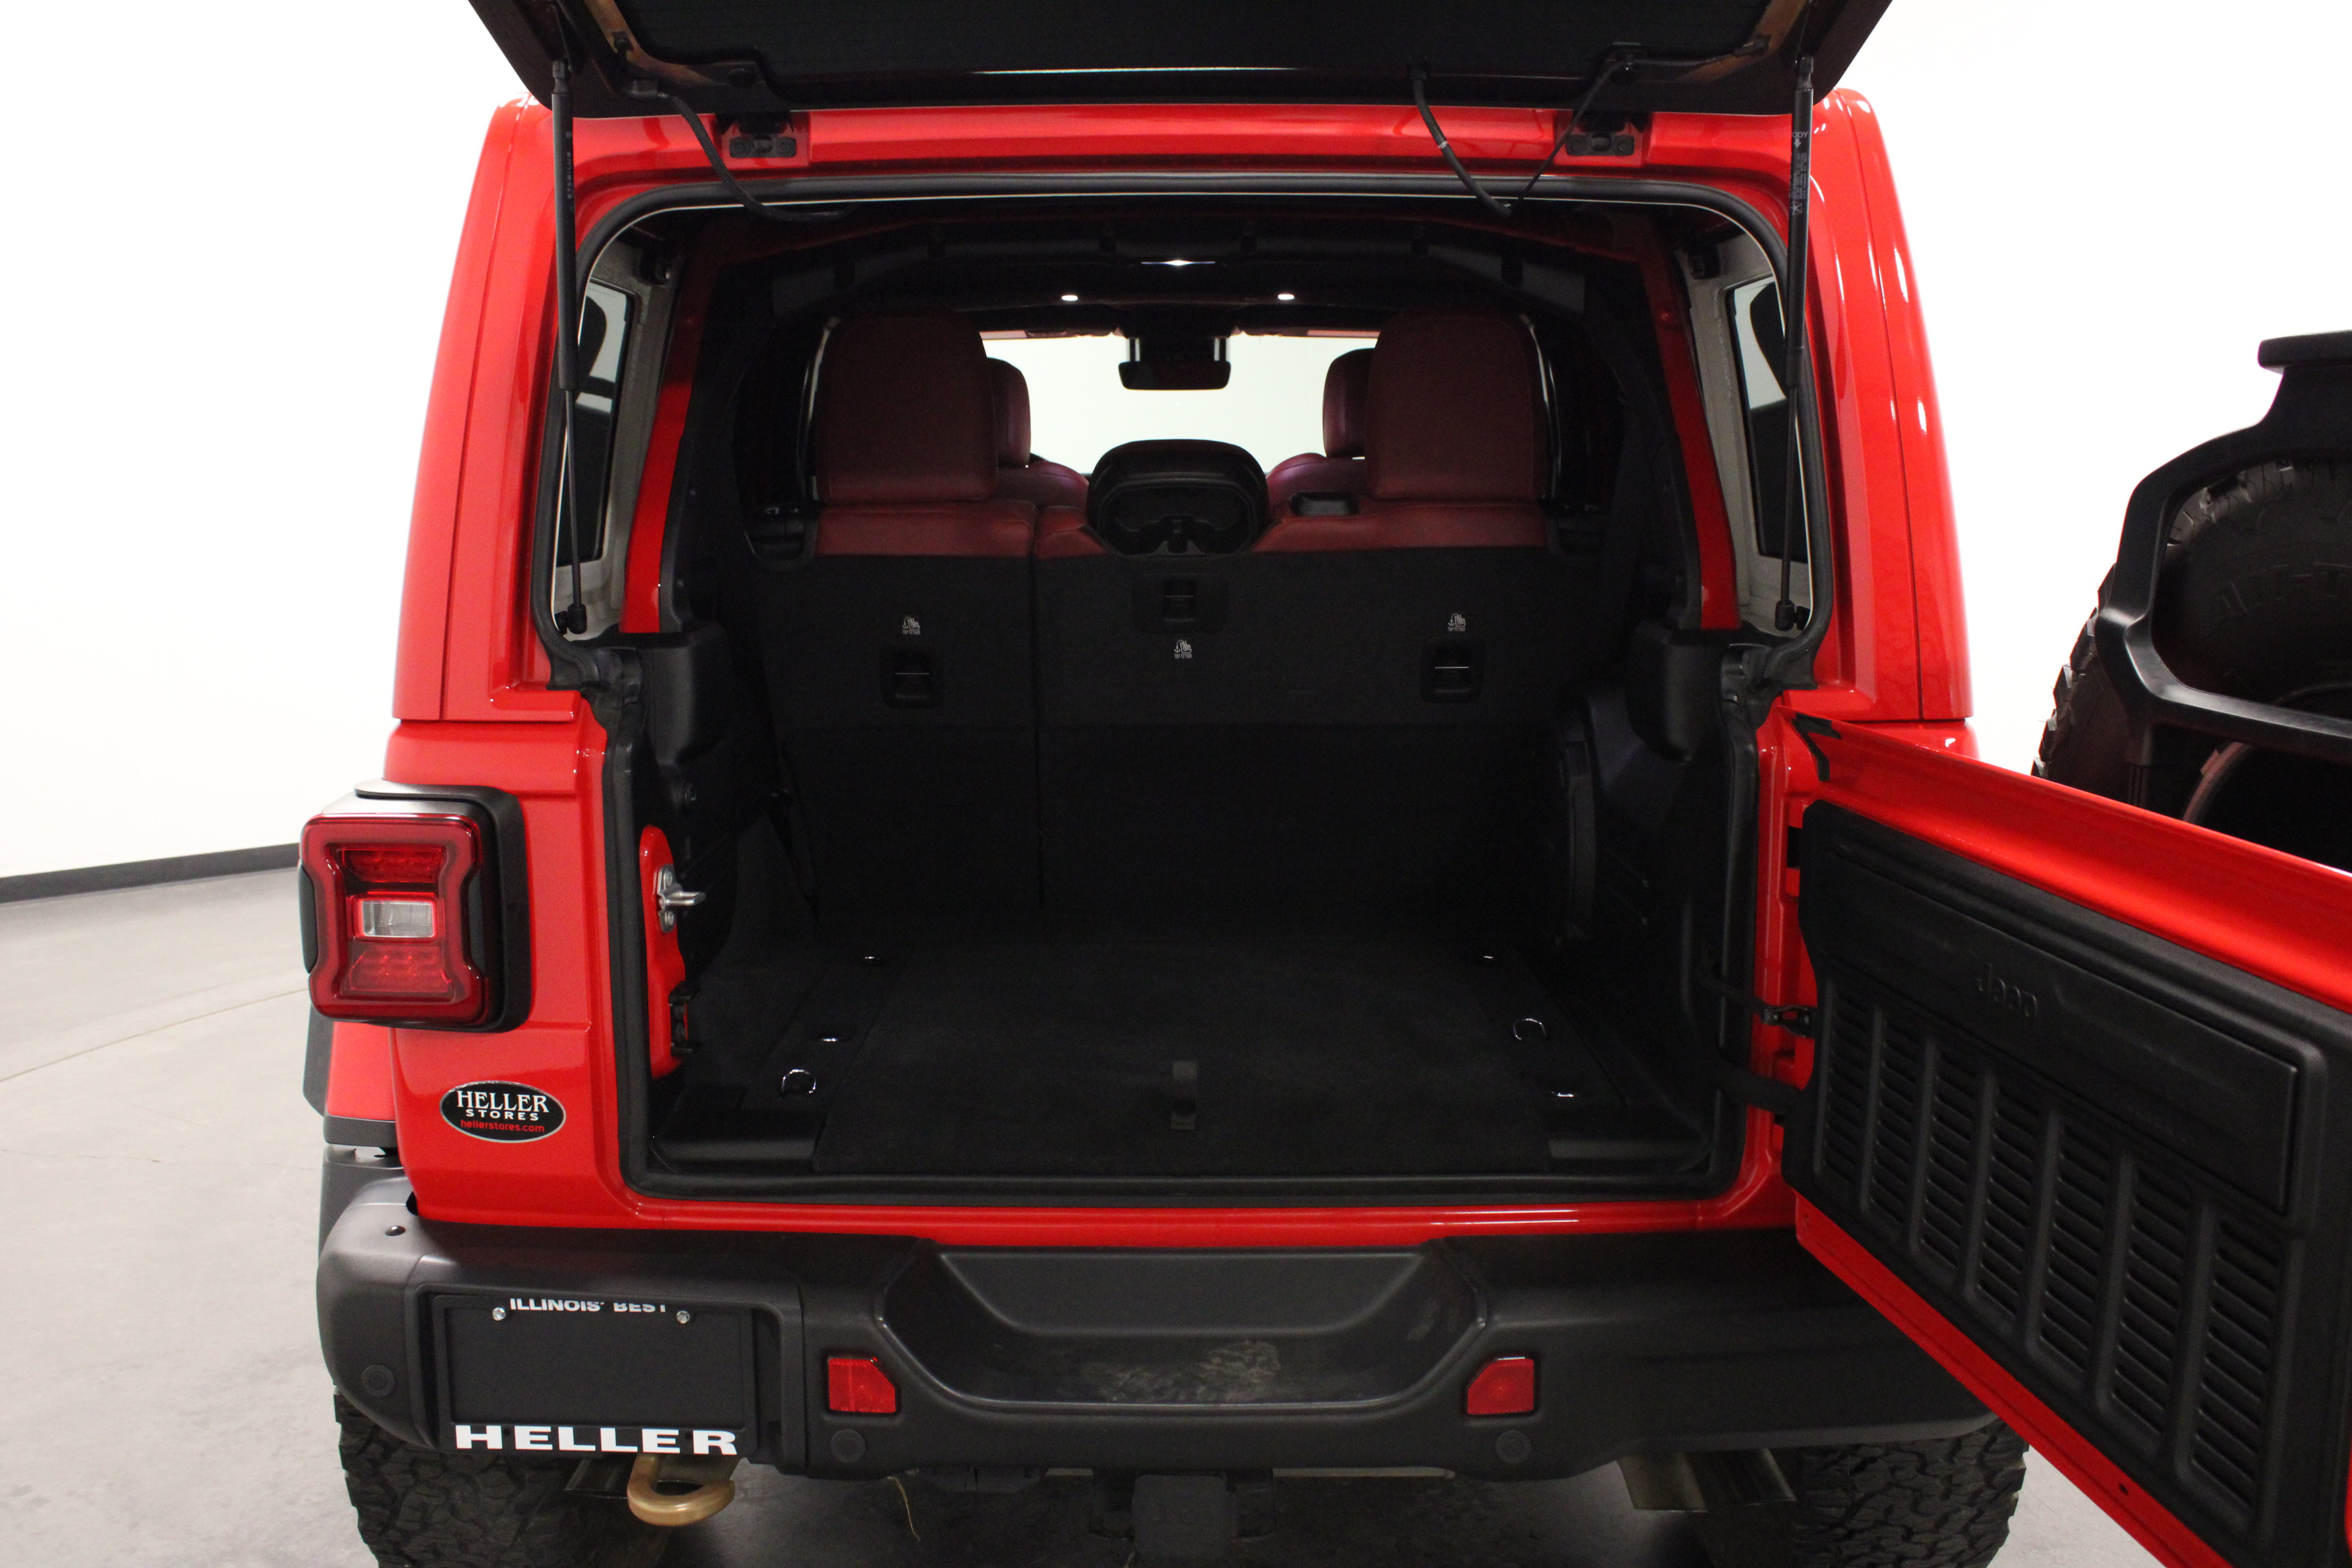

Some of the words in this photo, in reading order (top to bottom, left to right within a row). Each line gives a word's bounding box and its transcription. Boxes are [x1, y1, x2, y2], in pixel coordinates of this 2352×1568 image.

[457, 1090, 549, 1113] HELLER
[466, 1109, 539, 1121] STORES
[461, 1120, 545, 1132] hellerstores.com
[455, 1425, 737, 1455] HELLER
